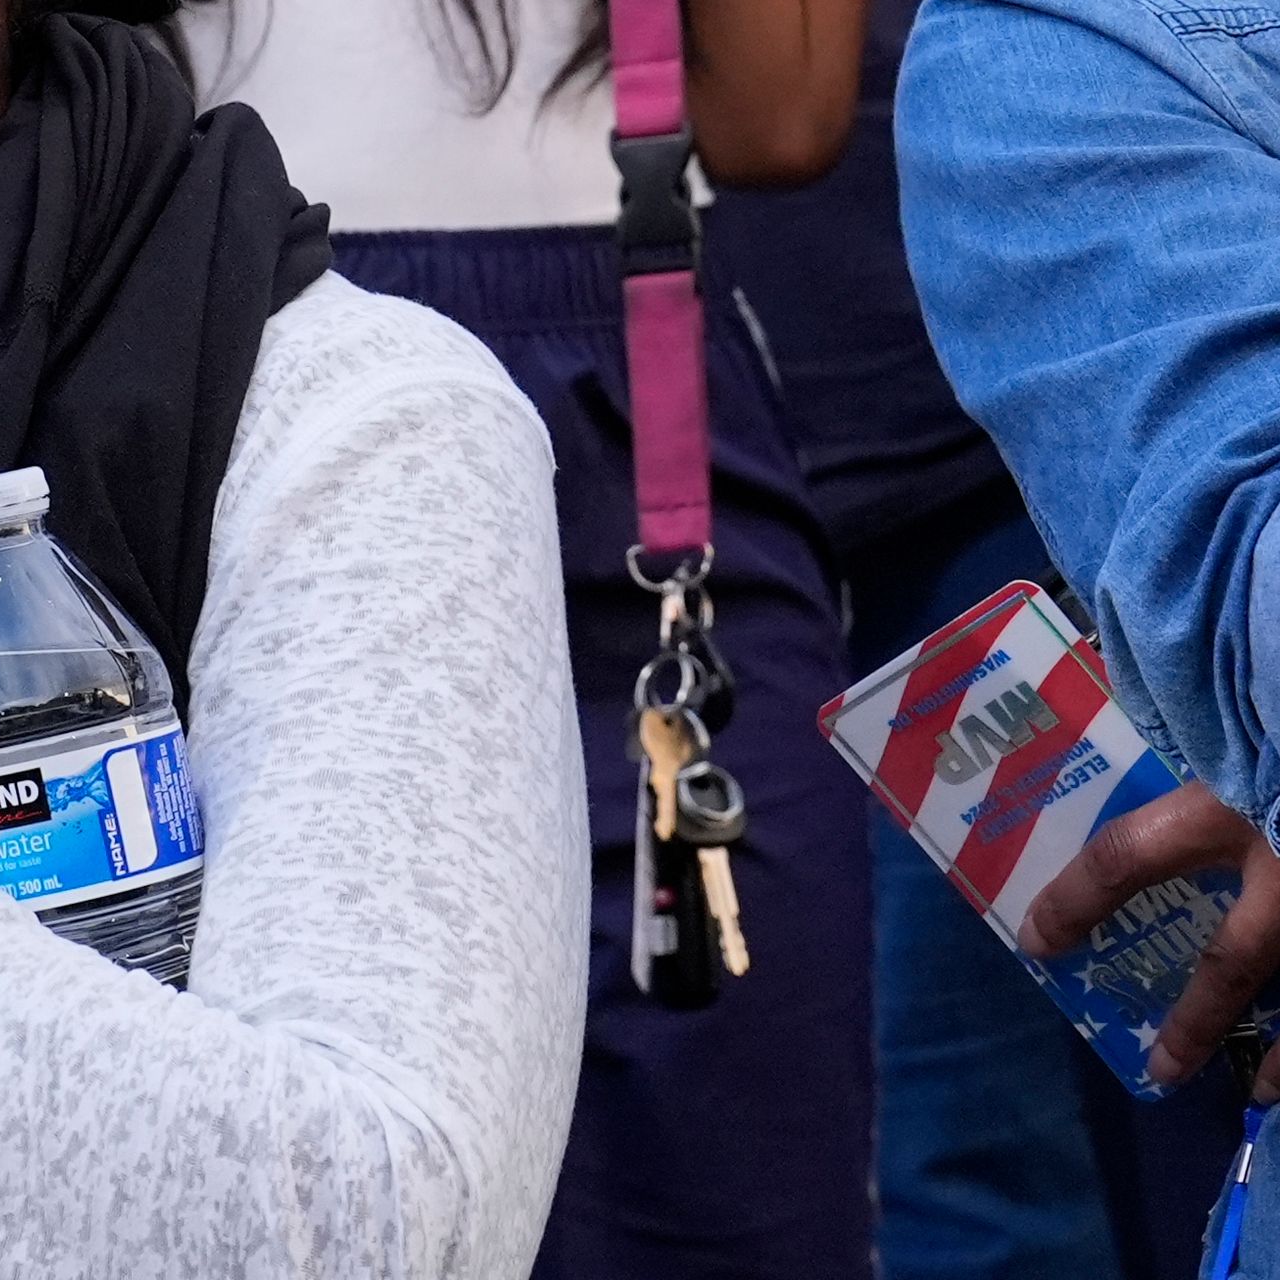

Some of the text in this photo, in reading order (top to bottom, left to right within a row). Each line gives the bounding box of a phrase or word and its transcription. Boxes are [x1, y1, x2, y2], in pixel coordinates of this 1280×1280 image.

[934, 680, 1060, 785] MVP
[1031, 753, 1111, 810] ELECTION
[105, 813, 126, 876] NAME:
[18, 878, 42, 896] 500
[43, 874, 63, 891] mL
[1093, 890, 1238, 1019] ARRIS
